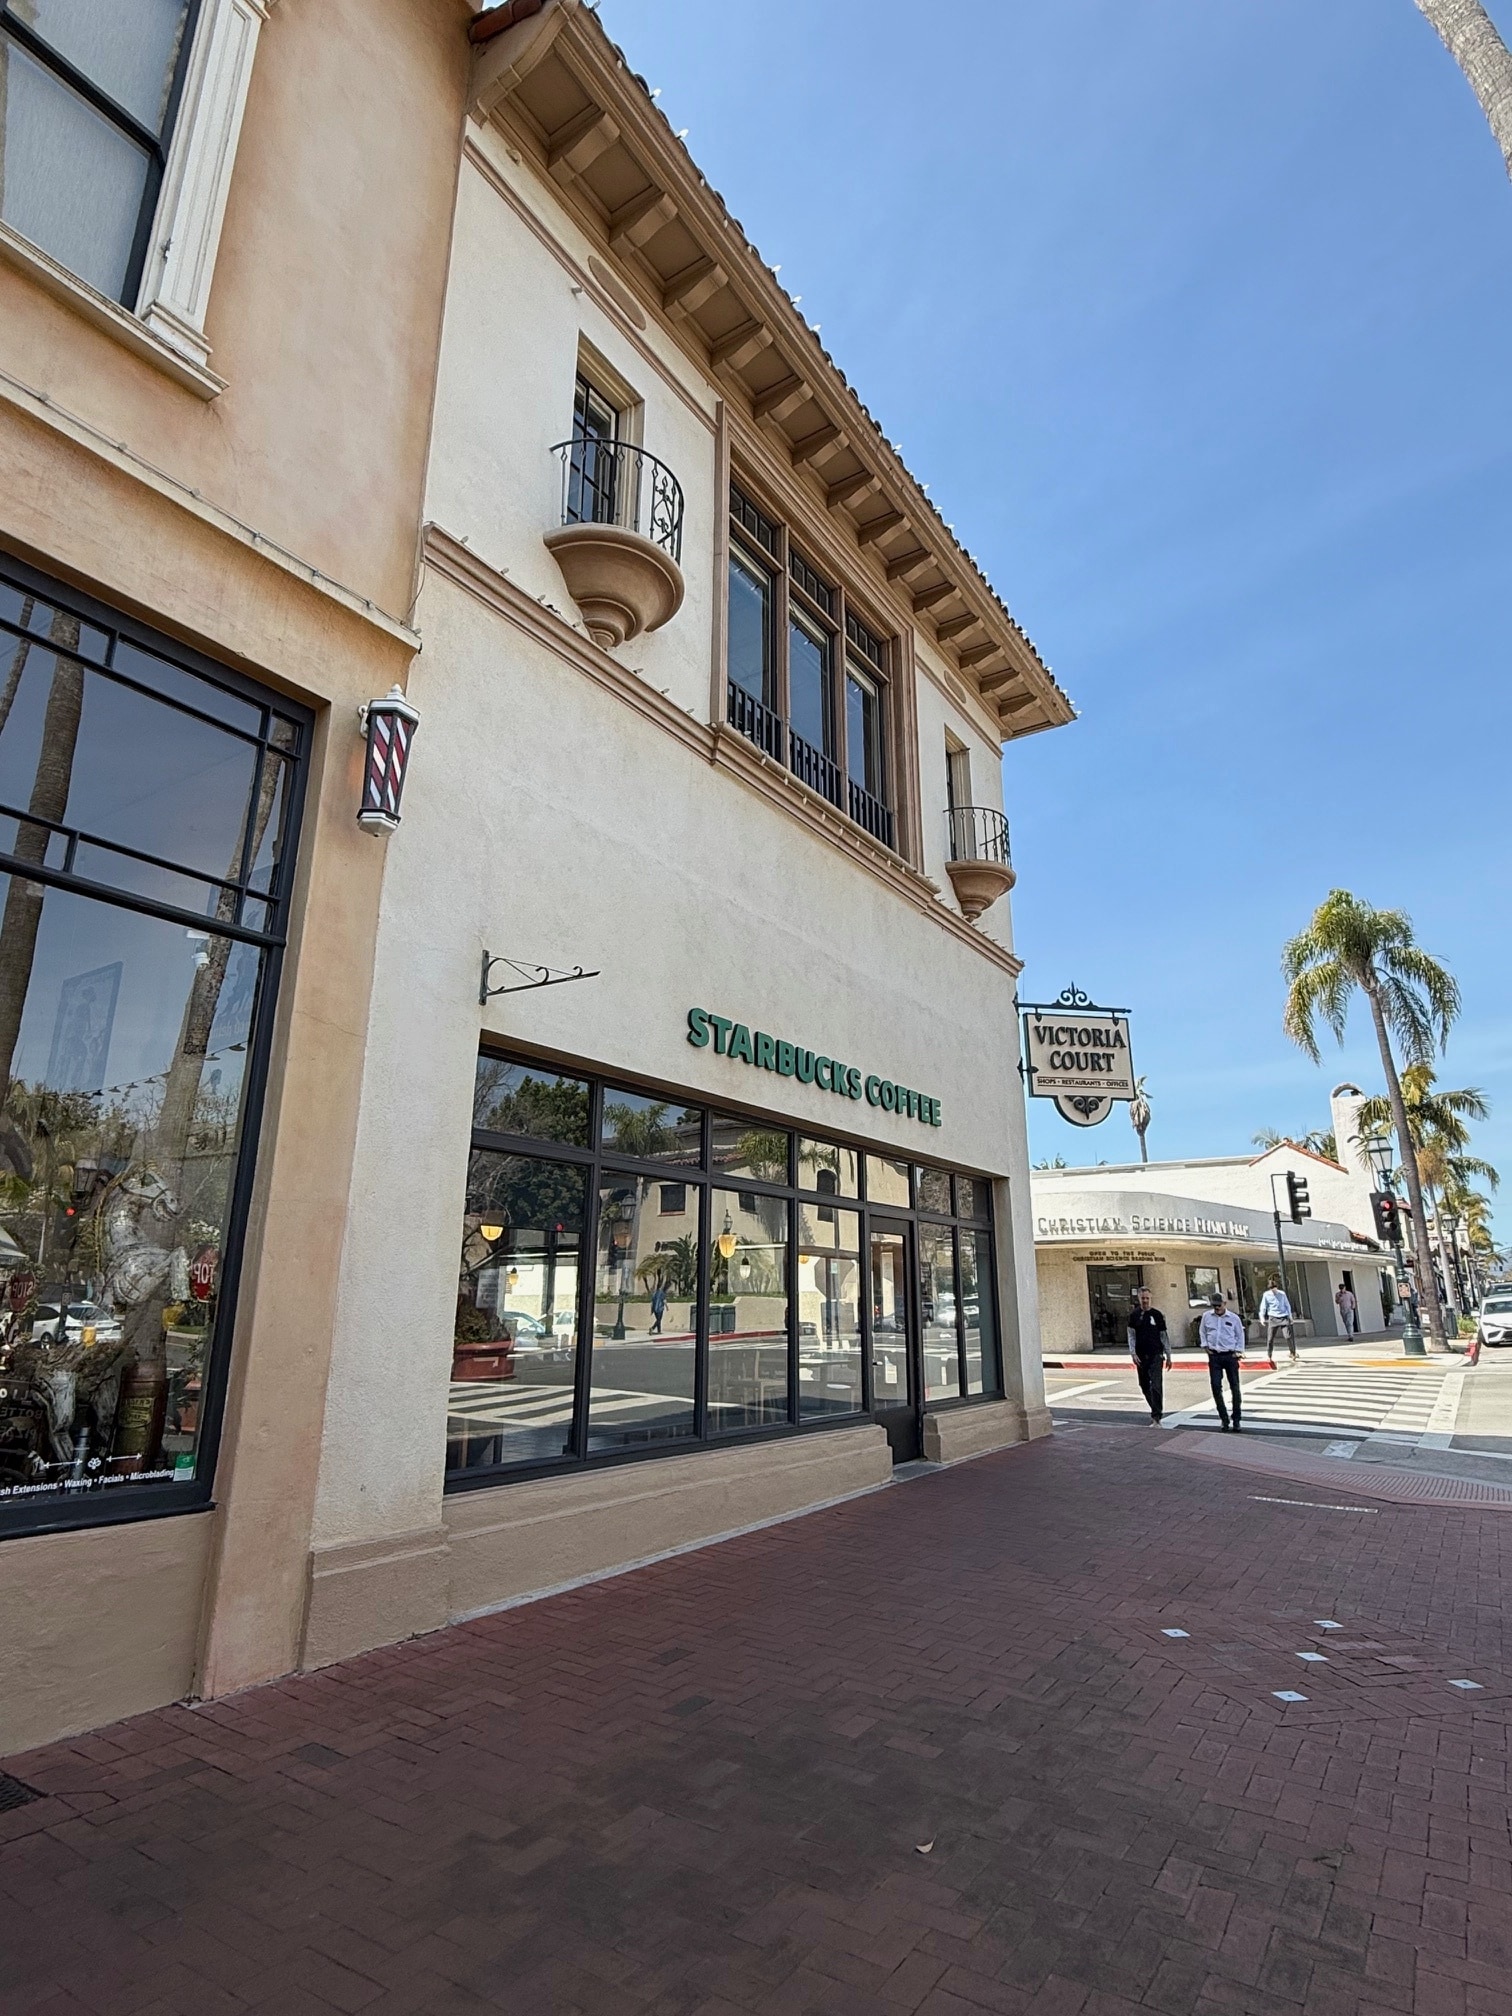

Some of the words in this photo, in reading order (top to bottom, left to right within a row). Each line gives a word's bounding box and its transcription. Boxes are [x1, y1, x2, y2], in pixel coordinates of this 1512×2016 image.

[1034, 1026, 1127, 1048] VICTORIA
[687, 1007, 862, 1101] STARBUCKS
[865, 1075, 942, 1127] COFFEE
[1050, 1050, 1115, 1072] COURT
[1038, 1217, 1121, 1232] CHRISTIAN
[1132, 1215, 1190, 1231] SCIENCE
[12, 1482, 58, 1495] Extensions
[64, 1477, 92, 1488] Waxing
[98, 1474, 124, 1484] Facials
[130, 1469, 174, 1481] Microblading
